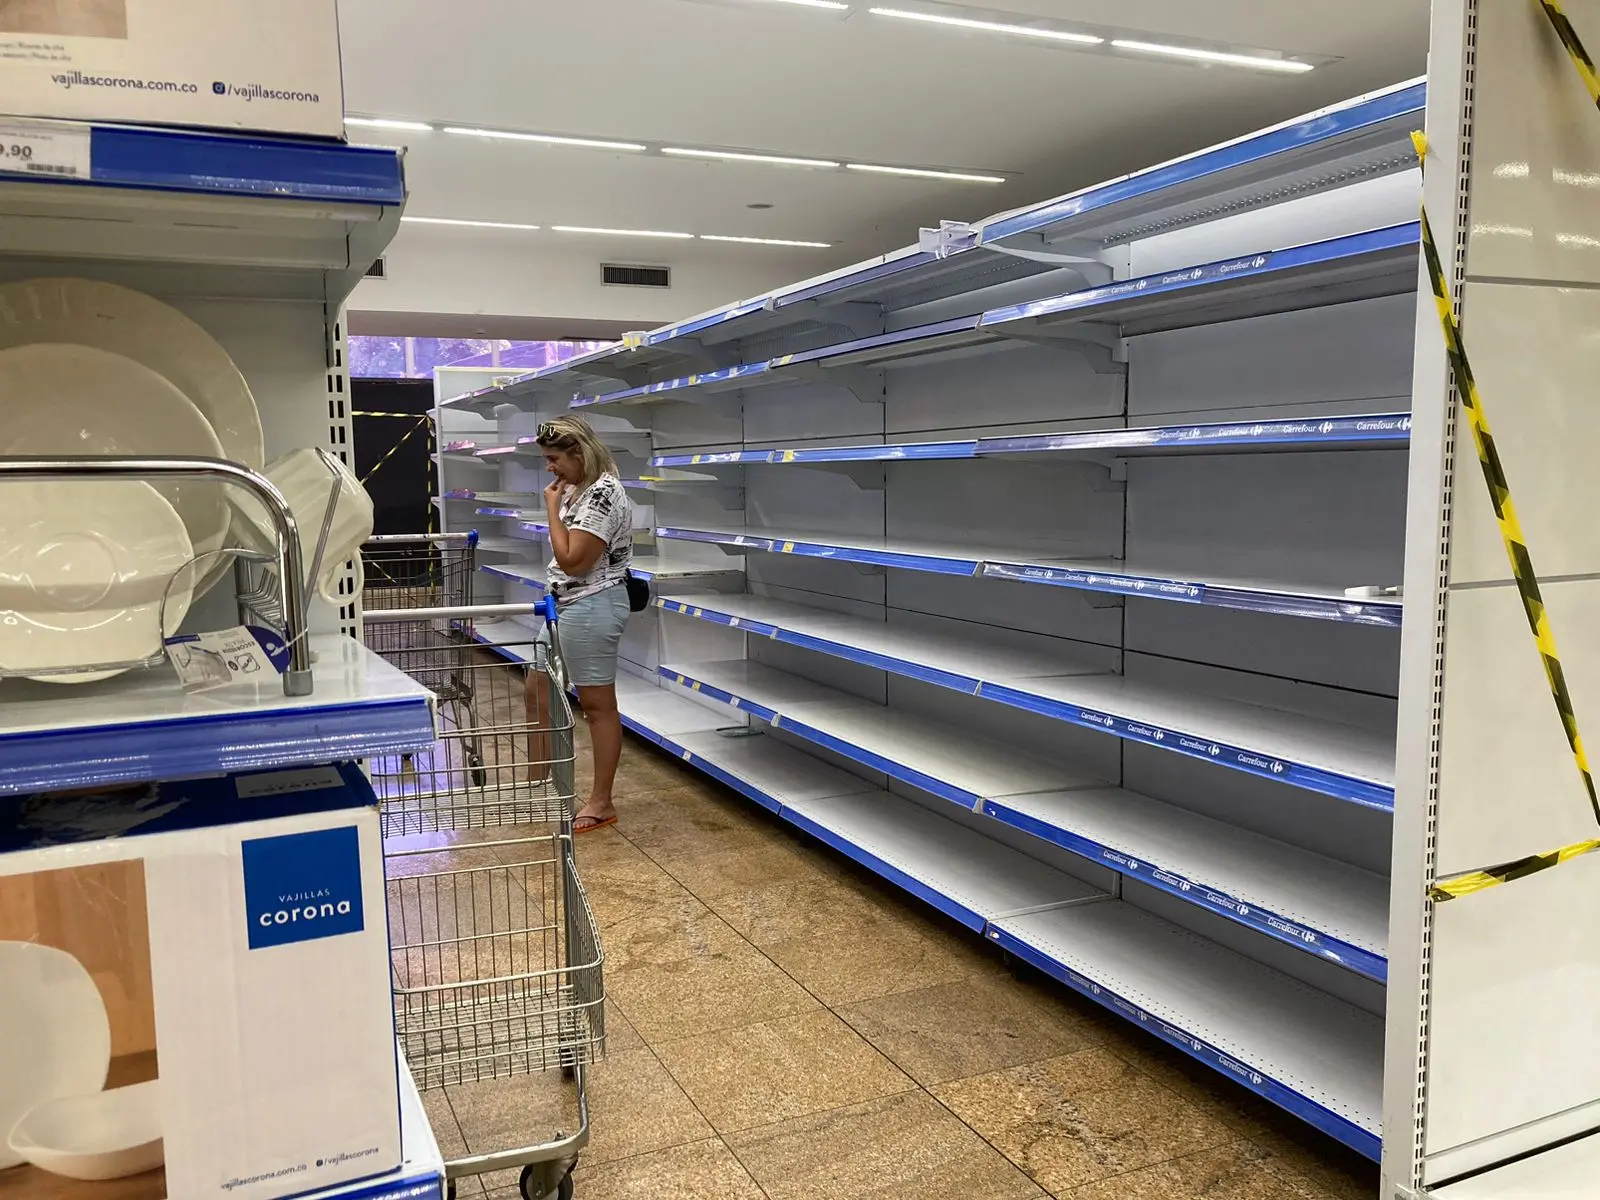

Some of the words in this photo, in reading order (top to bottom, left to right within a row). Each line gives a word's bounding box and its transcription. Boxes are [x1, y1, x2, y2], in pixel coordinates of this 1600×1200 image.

[51, 70, 198, 95] vajillascorona.com.co
[1162, 272, 1189, 285] Carrefour
[1220, 261, 1250, 274] Carrefour
[1282, 424, 1316, 434] Carrefour
[1356, 420, 1394, 431] Carrefour
[1065, 573, 1086, 583] Carrefour
[1110, 578, 1133, 588] Carrefour
[1159, 583, 1186, 595] Carrefour
[1081, 711, 1103, 723] Carrefour
[1127, 723, 1152, 736] Carrefour
[1179, 738, 1207, 752] Carrefour
[1237, 753, 1268, 769] Carrefour
[278, 888, 330, 904] VAJILLAS
[1103, 850, 1127, 865] Carrefour
[1152, 869, 1179, 886] Carrefour
[1206, 891, 1236, 910] Carrefour
[1267, 916, 1300, 936] Carrefour
[259, 899, 351, 928] corona
[1162, 1025, 1190, 1044] Carrefour
[1218, 1055, 1248, 1077] Carrefour
